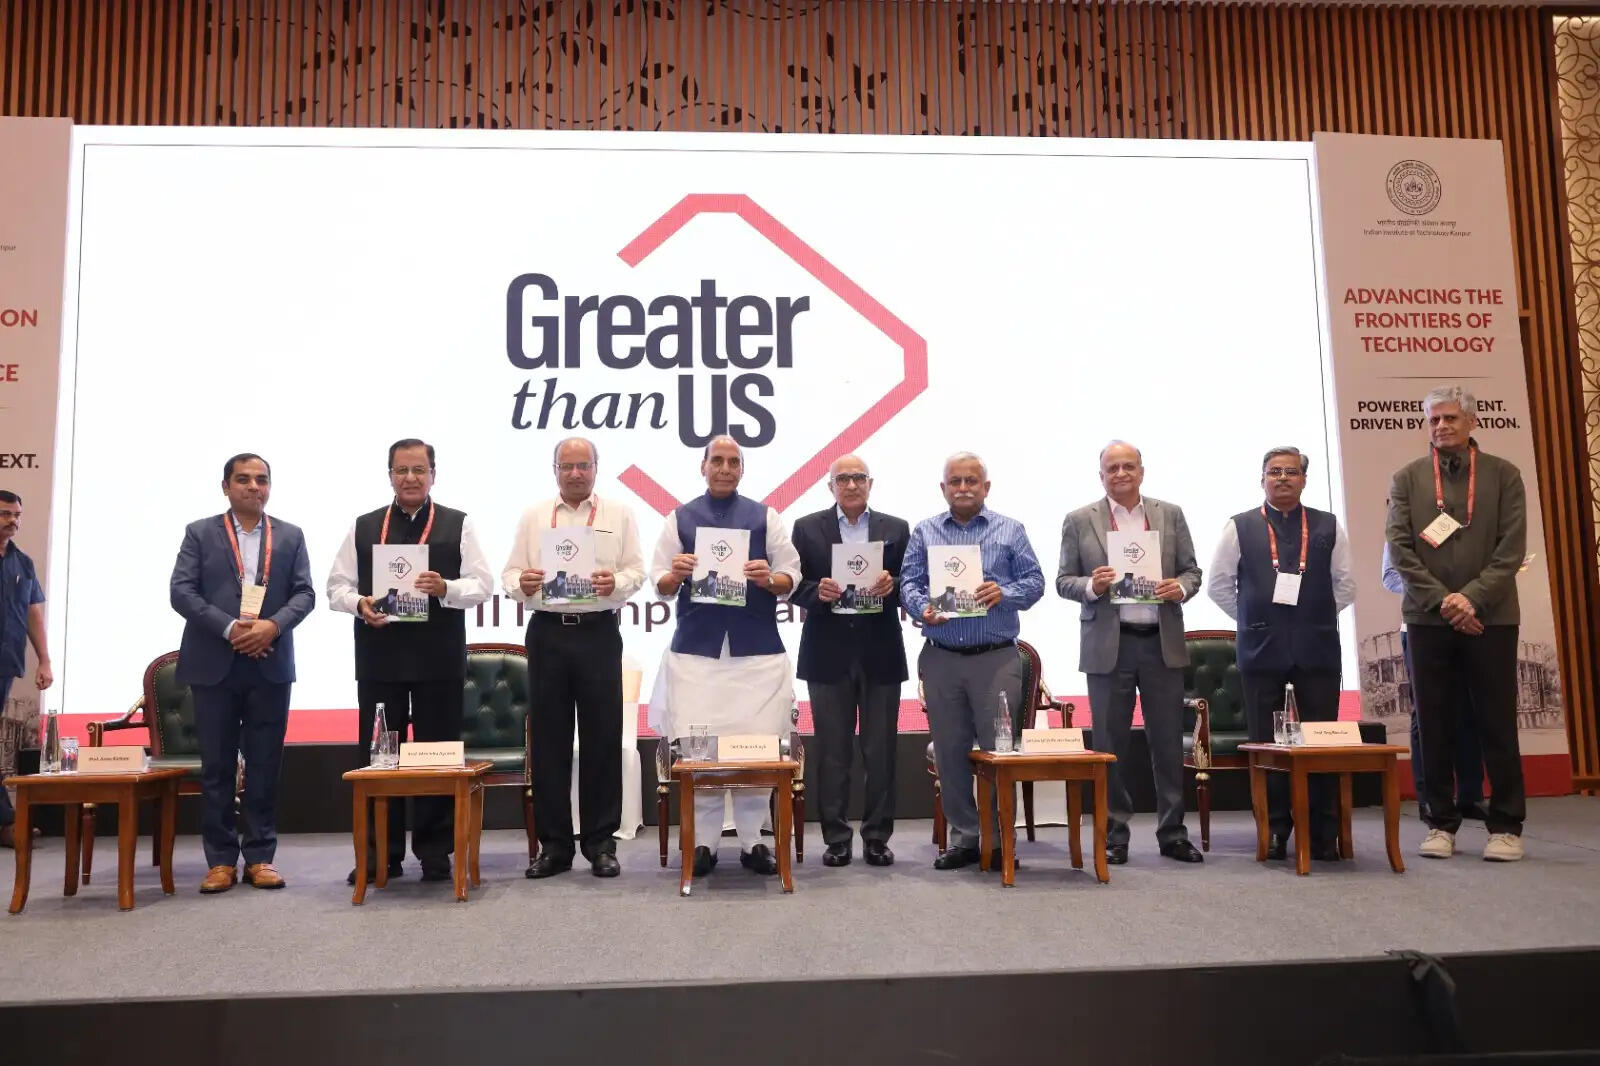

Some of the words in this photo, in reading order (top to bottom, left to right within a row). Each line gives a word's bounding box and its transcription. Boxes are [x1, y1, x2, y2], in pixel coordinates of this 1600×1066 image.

[1344, 288, 1462, 305] ADVANCING
[1465, 288, 1504, 305] THE
[506, 272, 810, 370] Greater
[1354, 312, 1462, 328] FRONTIERS
[1466, 312, 1492, 328] OF
[1360, 336, 1495, 353] TECHNOLOGY
[511, 377, 668, 430] than
[1350, 418, 1402, 430] DRIVEN
[1407, 418, 1424, 430] BY
